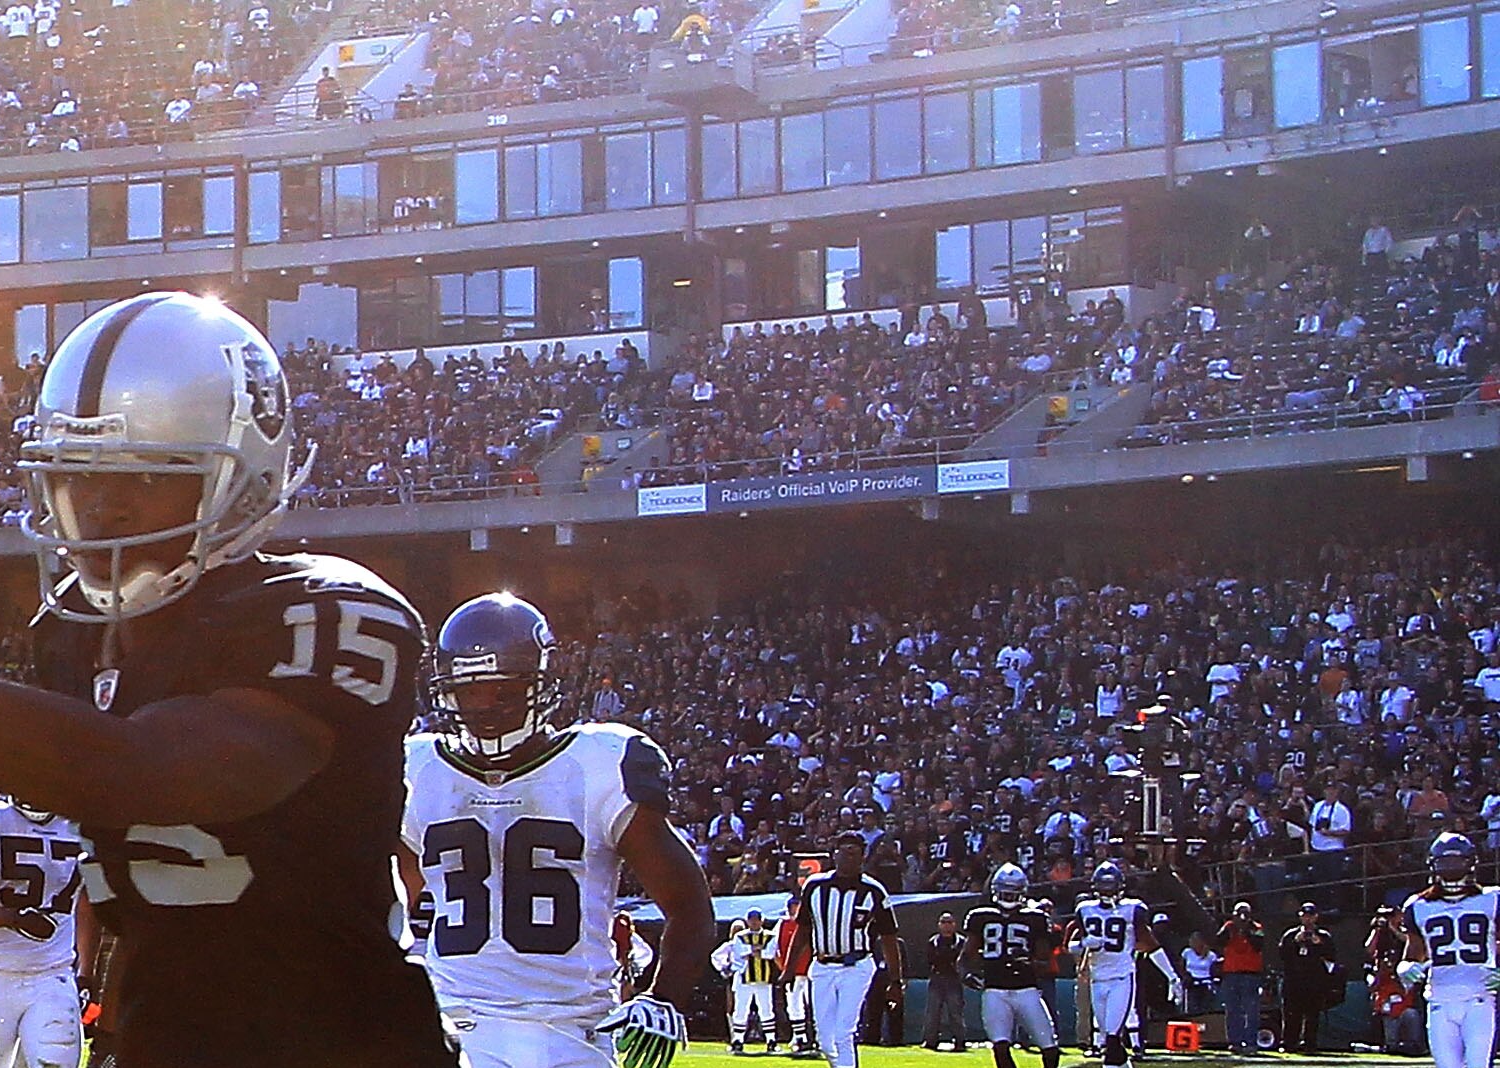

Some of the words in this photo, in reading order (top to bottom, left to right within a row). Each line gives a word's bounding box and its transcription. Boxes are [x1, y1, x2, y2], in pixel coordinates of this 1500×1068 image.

[721, 485, 775, 502] Raiders'
[778, 482, 825, 498] Official
[828, 478, 858, 494] VoIP
[862, 475, 923, 491] Provider.
[269, 600, 411, 705] 15
[0, 836, 83, 914] 57
[422, 817, 585, 955] 36
[983, 922, 1030, 958] 85
[1425, 914, 1489, 966] 29
[1173, 1026, 1194, 1048] G
